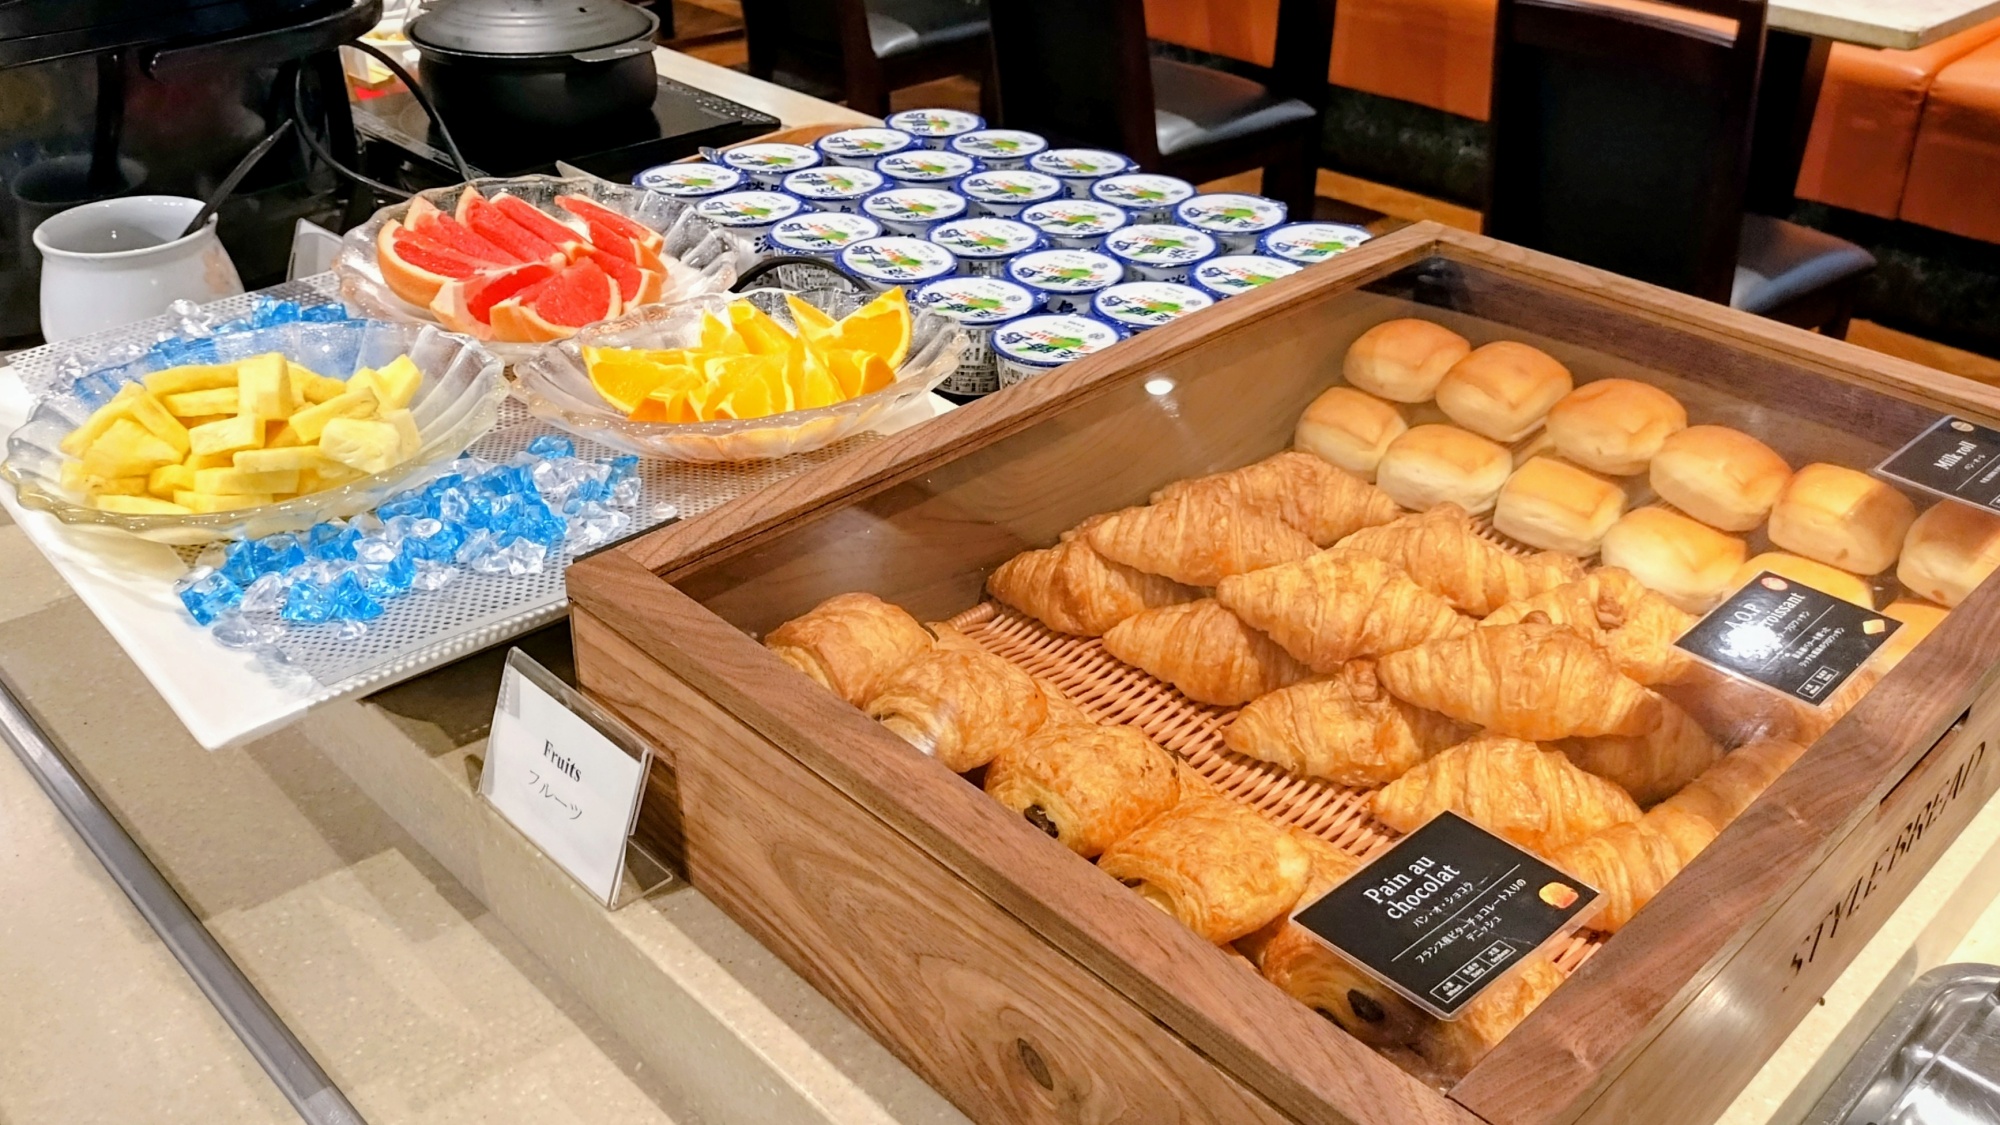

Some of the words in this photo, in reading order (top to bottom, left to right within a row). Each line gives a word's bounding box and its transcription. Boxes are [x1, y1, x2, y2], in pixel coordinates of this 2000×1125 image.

[1933, 453, 1963, 471] Milk
[1956, 440, 1977, 456] roll
[1724, 602, 1761, 629] AO.P
[543, 739, 582, 783] Fruits
[528, 769, 583, 820] フルーツ
[1363, 872, 1412, 905] Pain
[1408, 855, 1436, 876] au
[1387, 863, 1461, 920] chocolat
[1413, 881, 1474, 928] パン・オ・ショコラ
[1466, 916, 1502, 942] デニッシュ
